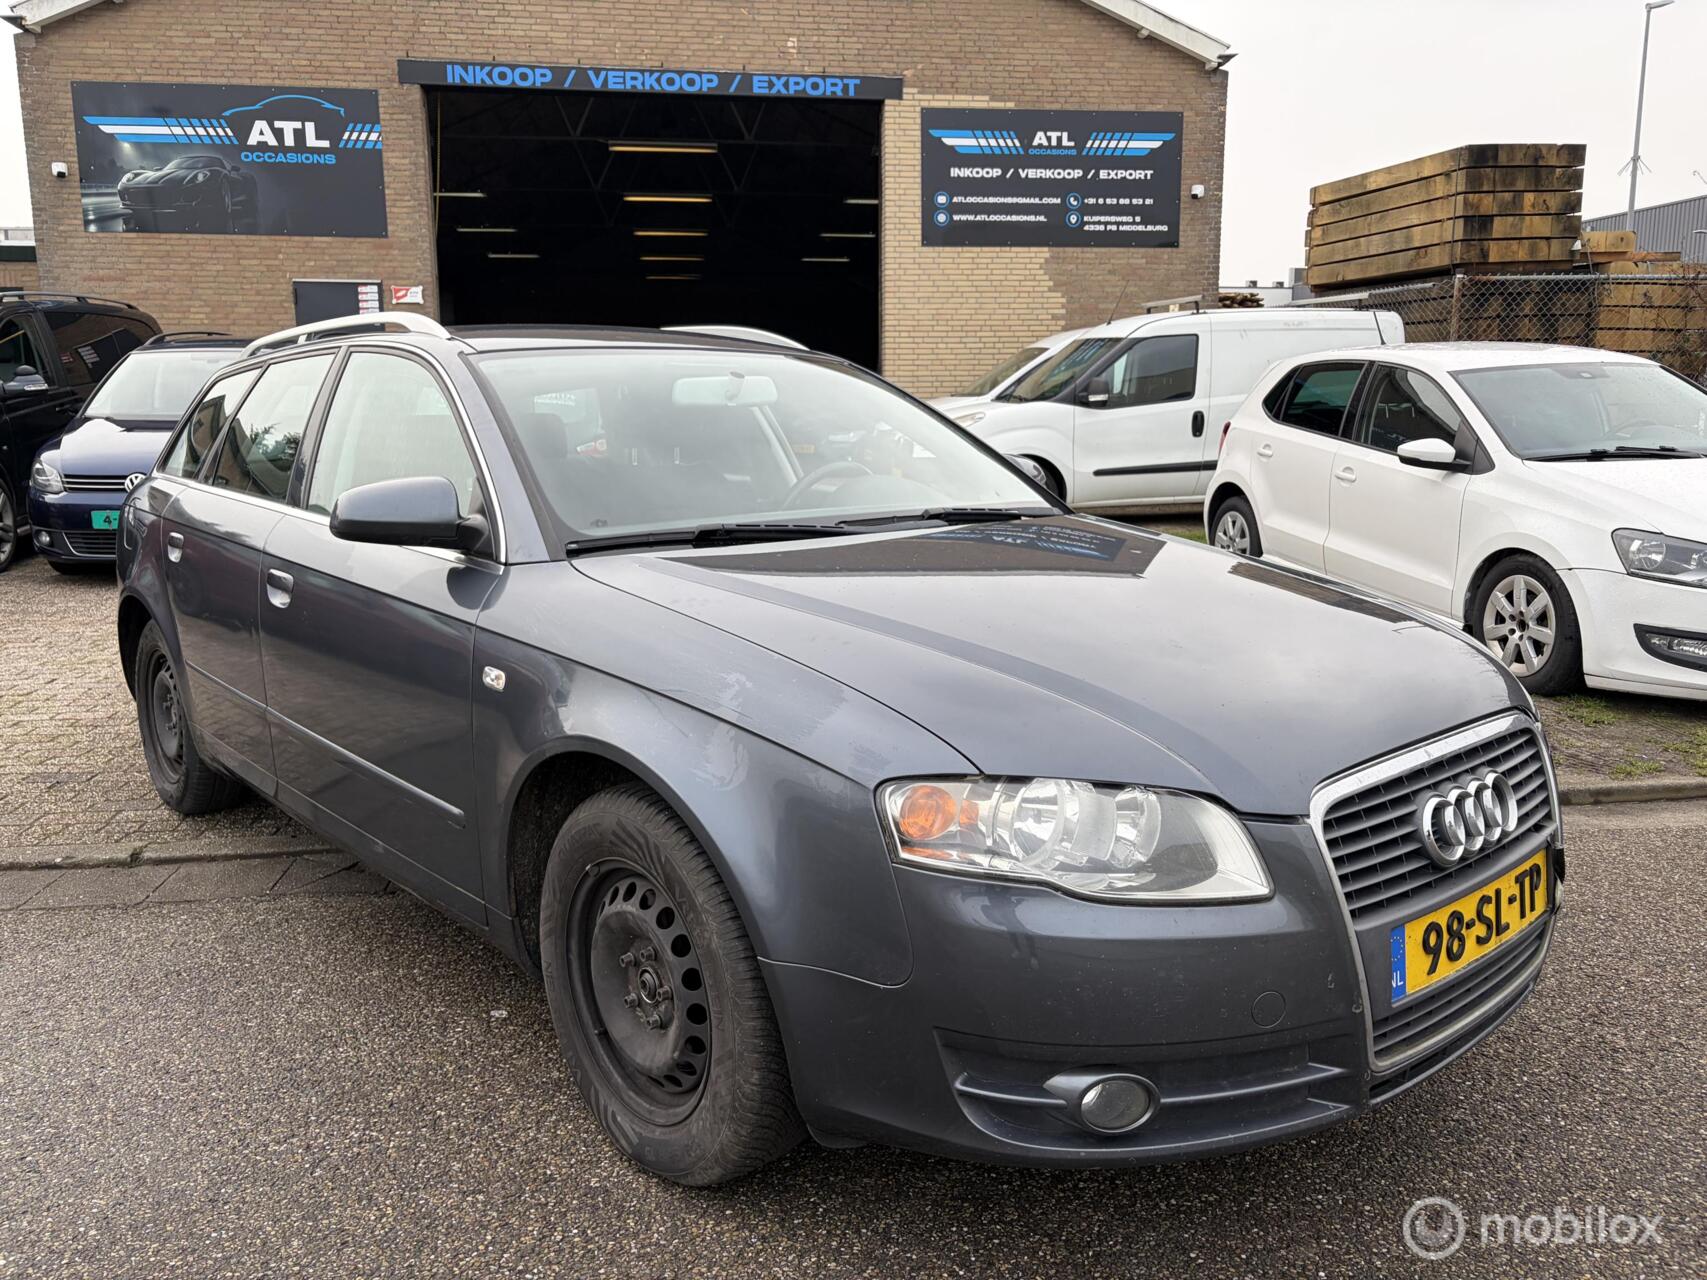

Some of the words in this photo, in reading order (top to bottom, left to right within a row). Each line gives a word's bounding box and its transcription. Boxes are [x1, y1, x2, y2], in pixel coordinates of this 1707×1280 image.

[446, 63, 554, 88] INKOOP
[564, 69, 577, 88] /
[587, 68, 720, 93] VERKOOP
[729, 74, 742, 93] /
[751, 74, 862, 97] EXPORT
[246, 119, 331, 148] ATL
[1031, 131, 1075, 147] ATL
[240, 150, 337, 166] OCCASIONS
[1027, 147, 1078, 156] OCCASIONS
[949, 166, 1003, 179] INKOOP
[1005, 167, 1015, 179] /
[1017, 167, 1084, 180] VERKOOP
[1086, 168, 1096, 180] /
[1098, 169, 1154, 180] EXPORT
[952, 213, 1048, 222] WWW.ATLOCCASIONS.NL
[1118, 224, 1169, 232] MIDDELBURG
[1422, 862, 1542, 976] 98-SL-TP
